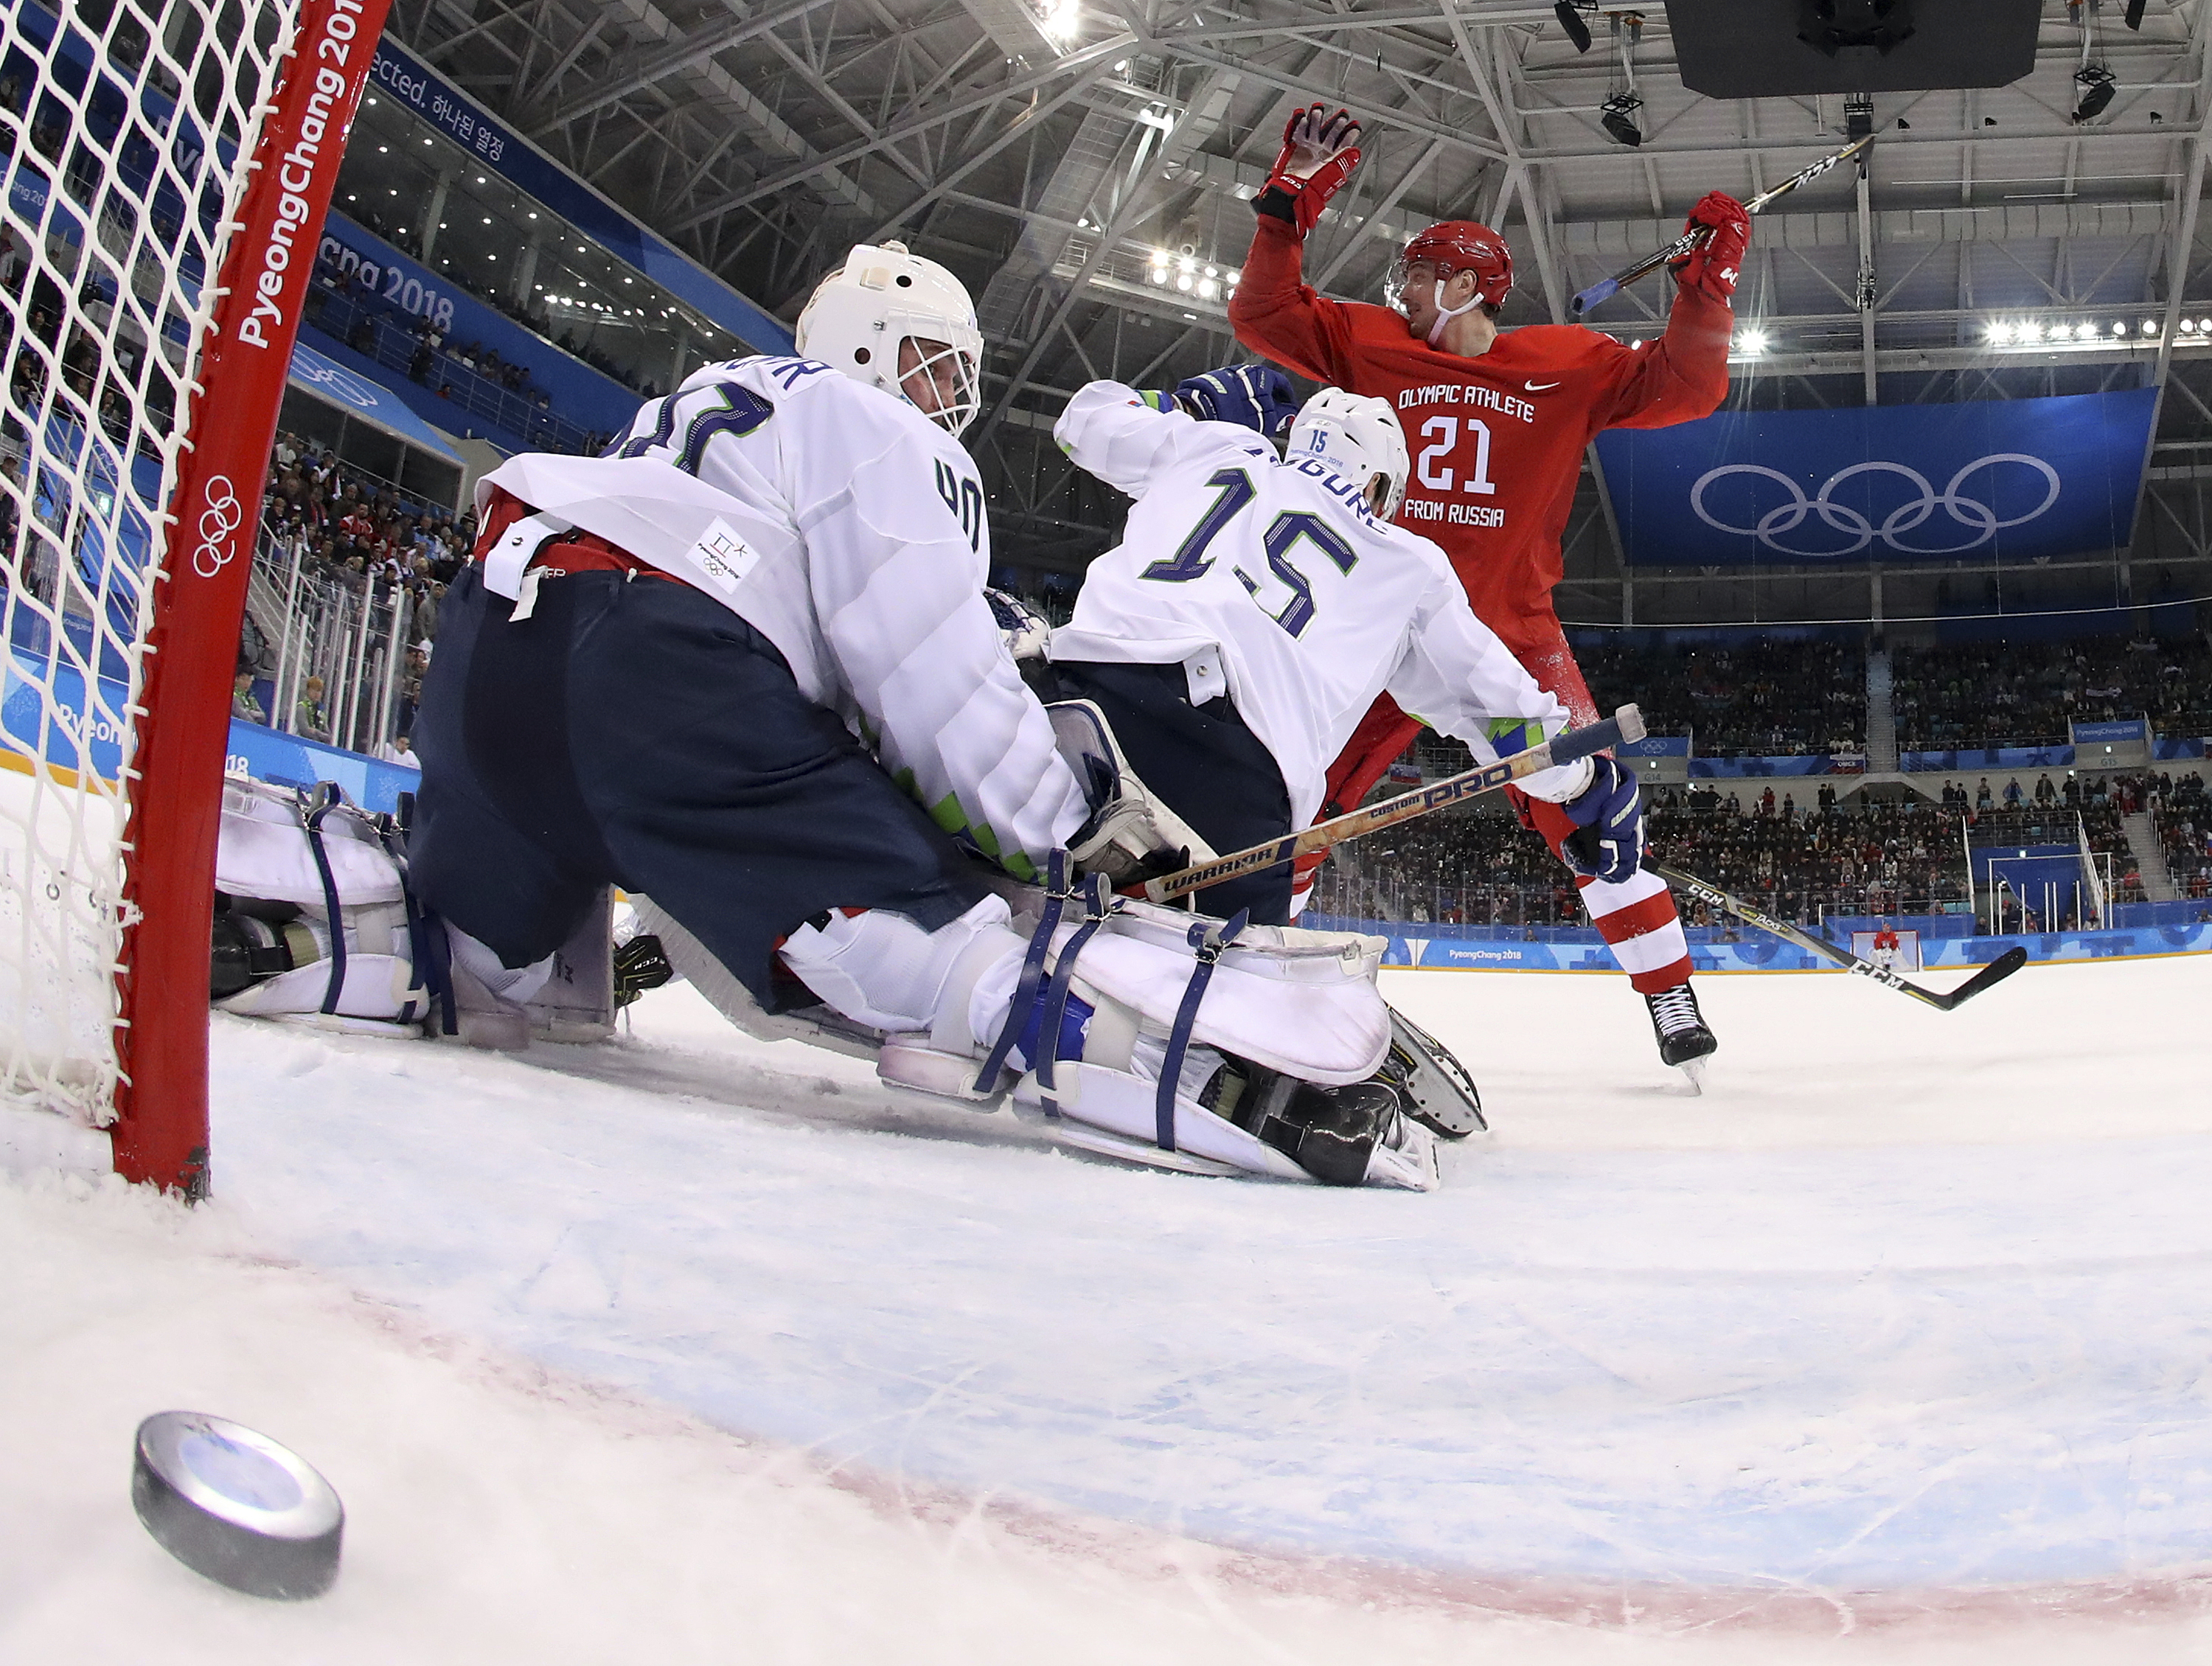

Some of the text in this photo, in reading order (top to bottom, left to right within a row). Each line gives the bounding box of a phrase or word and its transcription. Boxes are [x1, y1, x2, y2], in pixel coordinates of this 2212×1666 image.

[433, 94, 475, 141] 하나된
[476, 126, 504, 162] 열정
[238, 0, 366, 350] PyeongChang 201
[382, 266, 454, 335] 2018
[1398, 384, 1535, 423] OLYMPIC ATHLETE
[1309, 429, 1329, 454] 15
[1417, 415, 1496, 495] 21
[1405, 499, 1505, 528] FROM RUSSIA
[1137, 467, 1360, 643] 15
[2076, 726, 2123, 737] PyeongChang
[1424, 763, 1512, 809] PRO
[1164, 847, 1273, 892] WARRIOR
[1688, 884, 1725, 905] CCM
[1449, 949, 1522, 961] PyeongChang 2018
[1850, 959, 1905, 990] CCM
